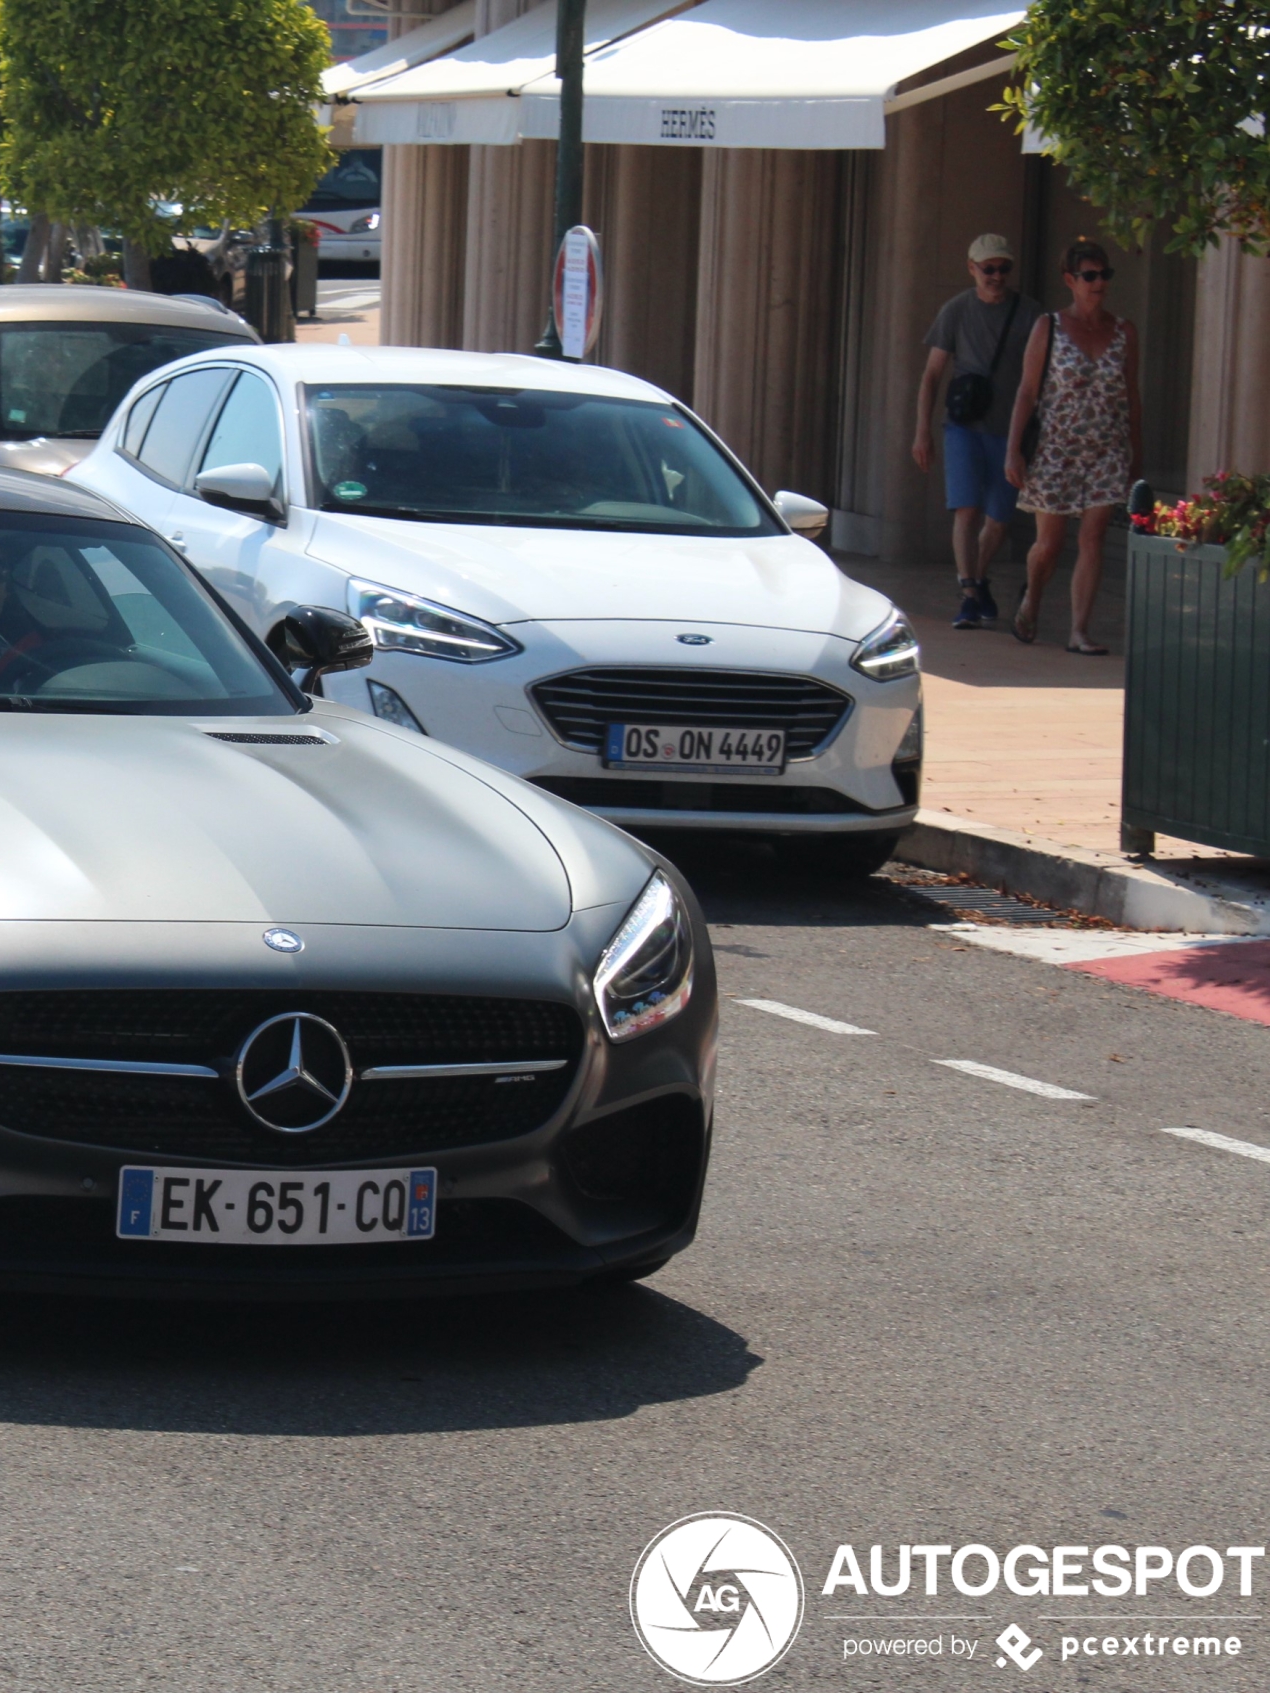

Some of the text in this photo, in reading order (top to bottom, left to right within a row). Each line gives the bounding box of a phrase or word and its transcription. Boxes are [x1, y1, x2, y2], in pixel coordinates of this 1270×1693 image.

[625, 727, 781, 763] OS ON 4449
[130, 1210, 141, 1225] F
[411, 1206, 430, 1232] 13
